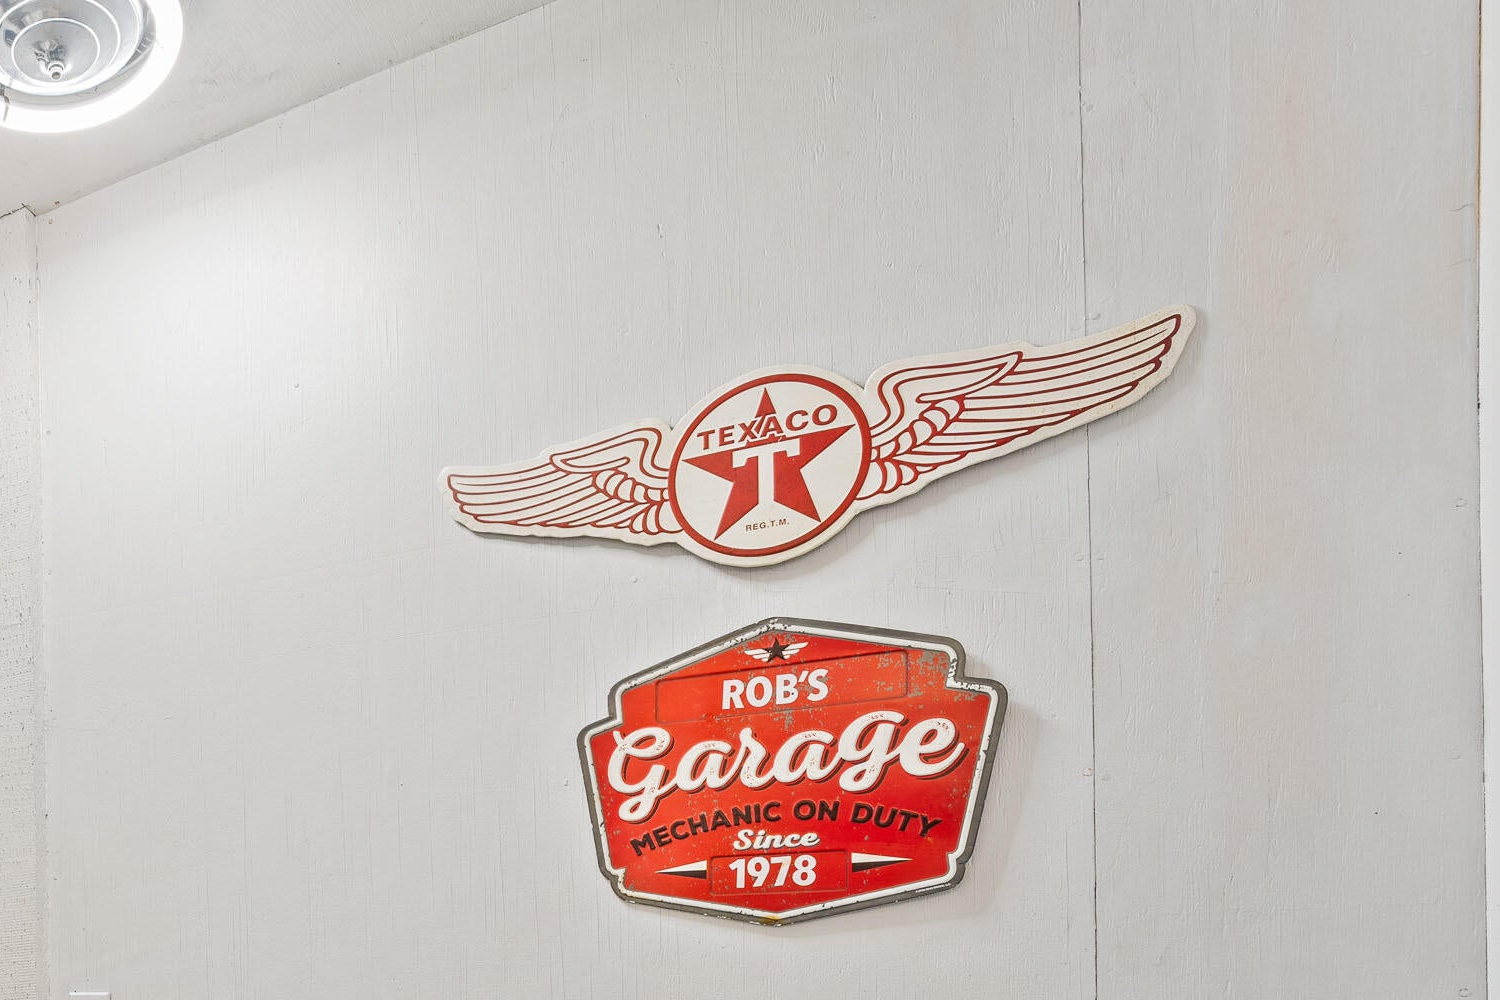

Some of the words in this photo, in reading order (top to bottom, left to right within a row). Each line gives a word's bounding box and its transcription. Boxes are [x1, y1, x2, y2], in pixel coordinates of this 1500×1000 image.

[697, 404, 838, 450] TEXACO
[732, 438, 800, 512] T
[721, 668, 829, 710] ROB'S
[607, 710, 966, 822] Garage
[630, 801, 781, 857] MECHANIC
[793, 799, 840, 822] ON
[852, 802, 944, 837] DUTY
[732, 829, 820, 852] Since
[729, 855, 817, 889] 1978
